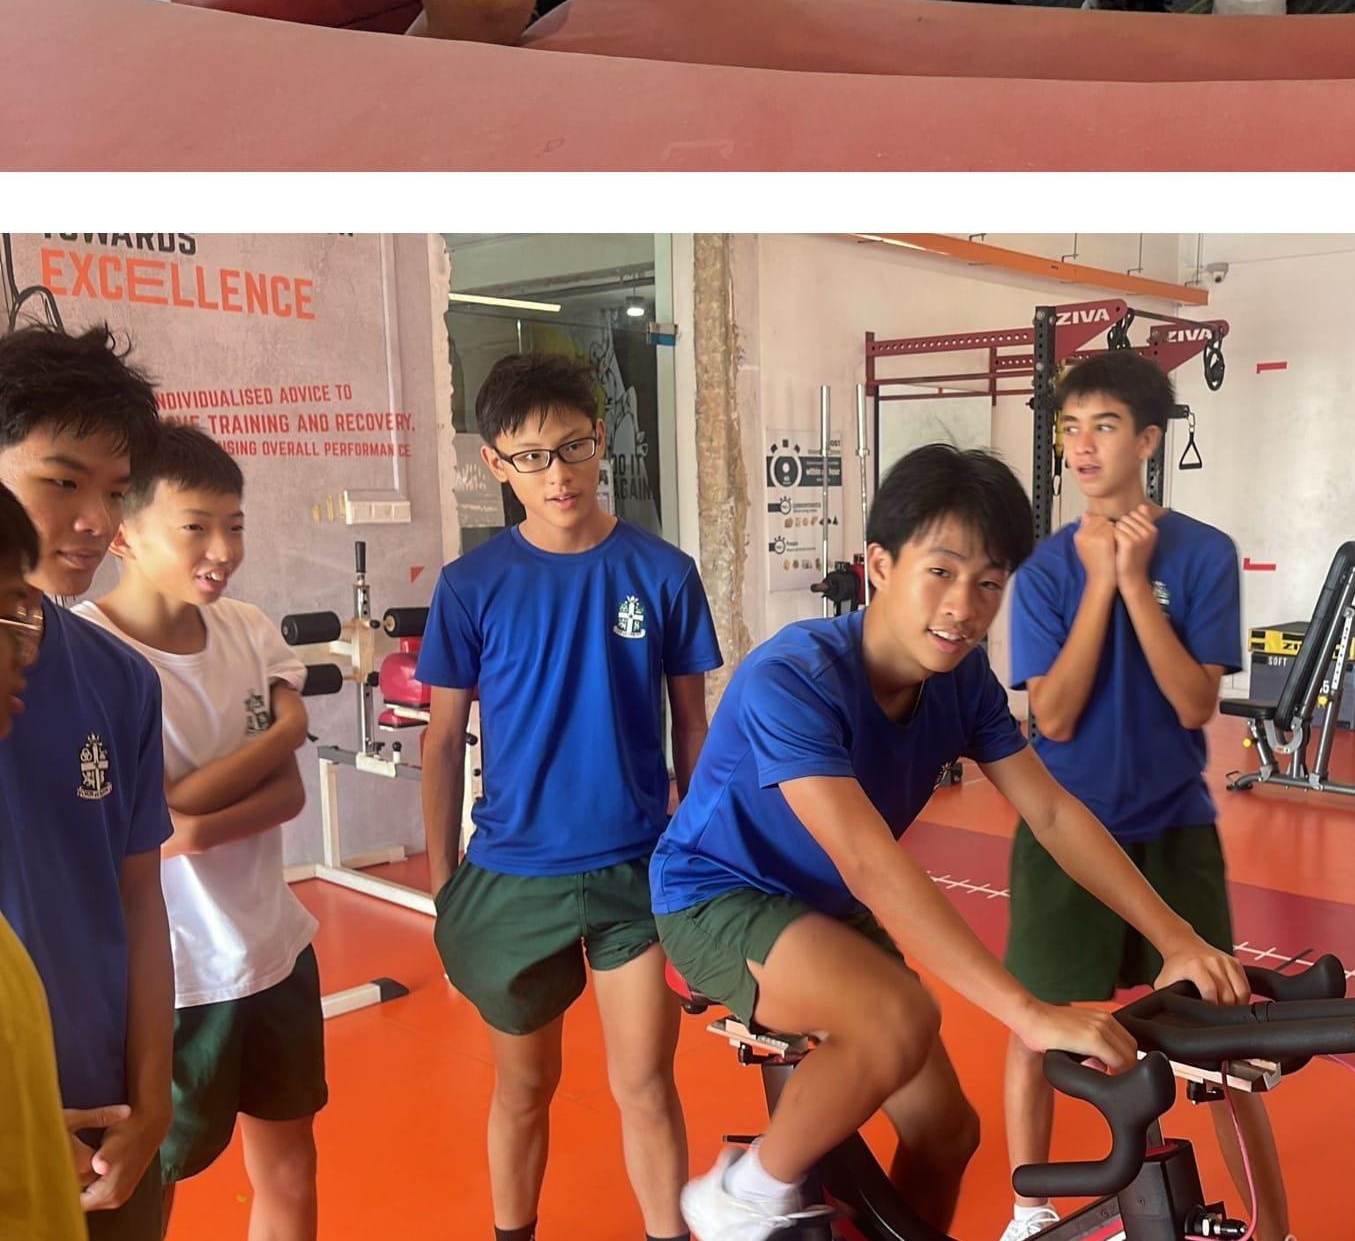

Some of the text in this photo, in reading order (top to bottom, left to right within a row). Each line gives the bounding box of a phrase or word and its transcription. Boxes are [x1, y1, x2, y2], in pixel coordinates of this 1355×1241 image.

[40, 247, 316, 320] EXCELLENCE
[1056, 308, 1110, 326] ZIVA
[1168, 328, 1213, 343] ZIVA
[156, 384, 353, 410] NDIVIDUALISED ADVICE TO
[208, 414, 290, 435] TRAINING
[297, 413, 330, 433] AND
[335, 412, 416, 433] RECOVERY,
[262, 441, 320, 457] OVERALL
[1267, 655, 1287, 667] SOFT
